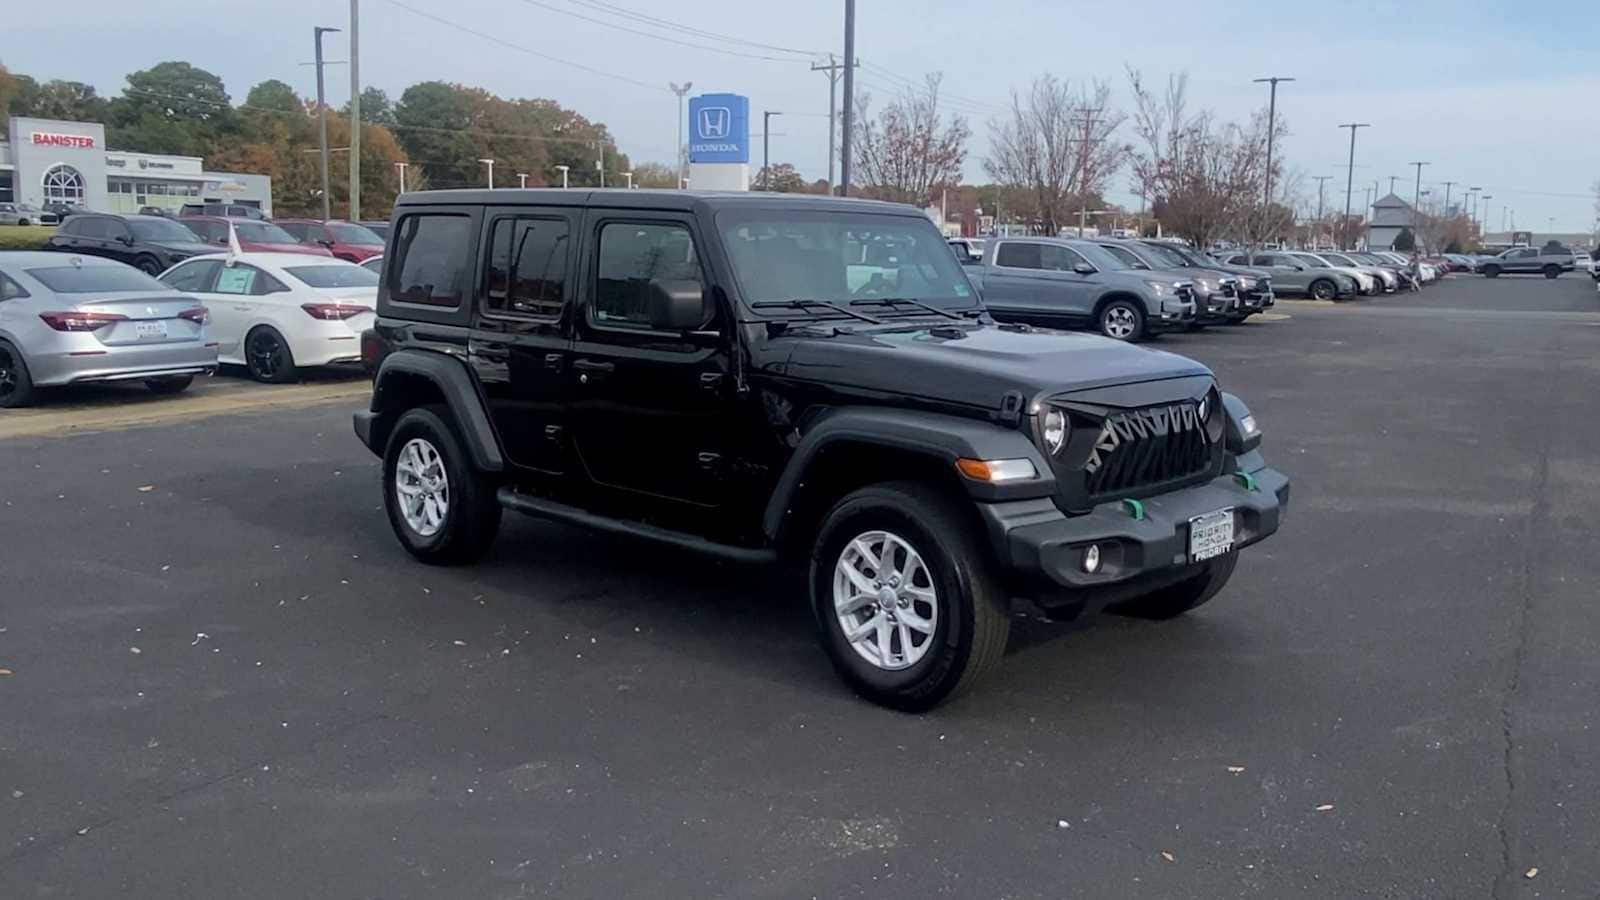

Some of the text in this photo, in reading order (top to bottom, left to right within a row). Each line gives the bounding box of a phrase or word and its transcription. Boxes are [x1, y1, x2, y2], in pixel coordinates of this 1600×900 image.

[32, 133, 94, 149] BANISTER
[691, 143, 740, 153] HONDA
[1192, 522, 1231, 539] PRIORITY
[1198, 533, 1227, 548] HONDA
[1195, 543, 1231, 562] PRIORITY
